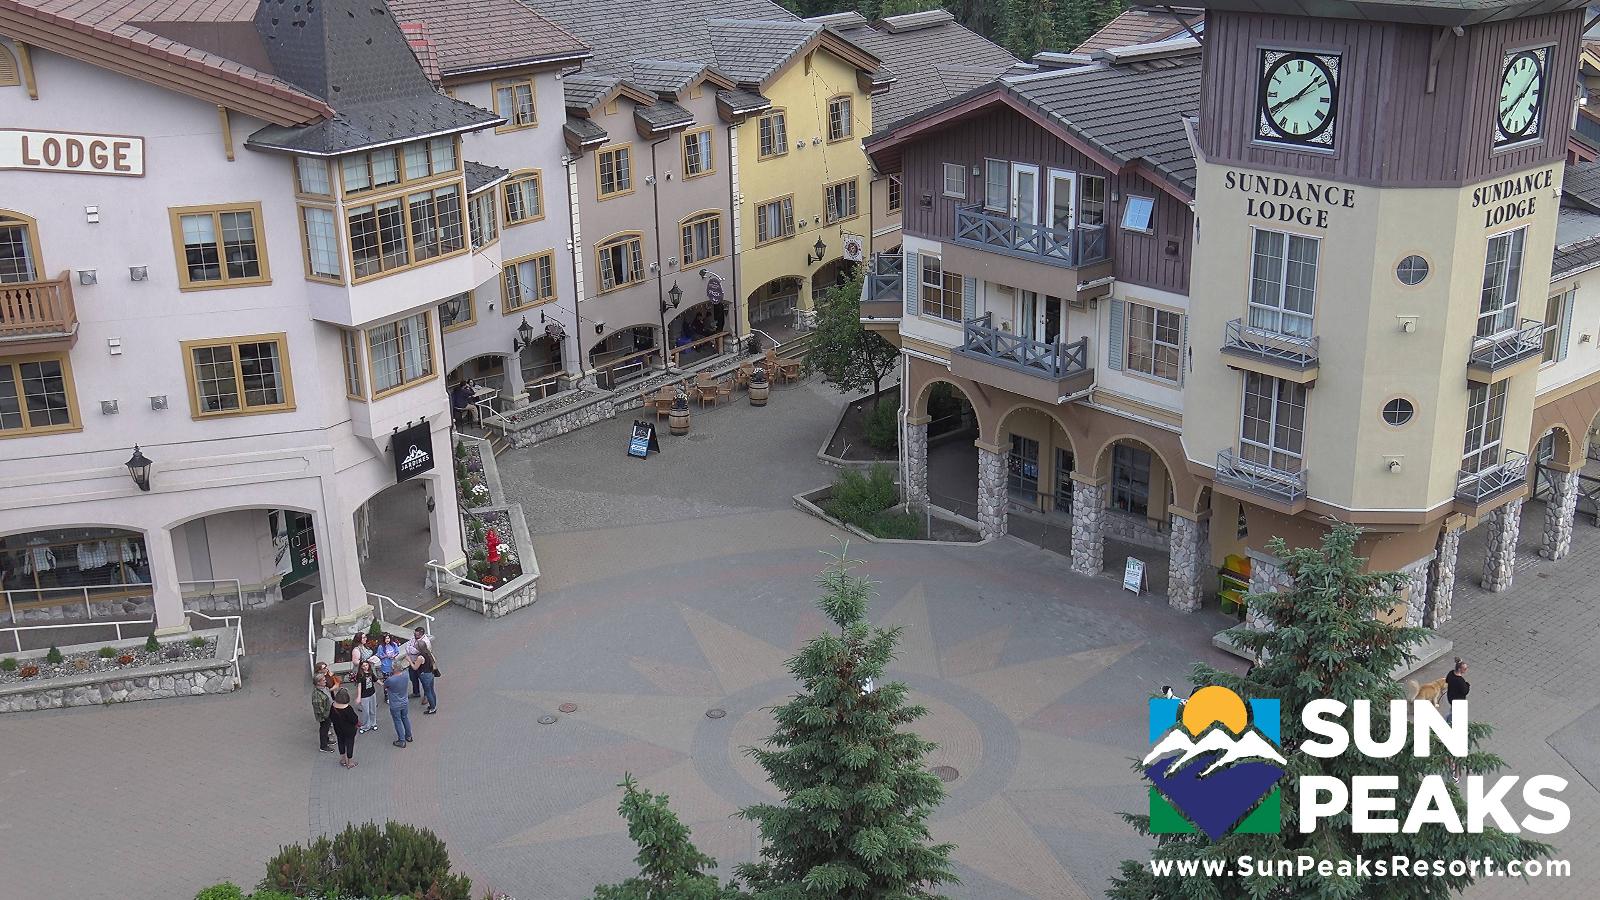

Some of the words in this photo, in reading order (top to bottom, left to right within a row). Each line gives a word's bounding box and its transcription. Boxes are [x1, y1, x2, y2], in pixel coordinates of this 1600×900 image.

[21, 135, 132, 172] LODGE
[1225, 171, 1355, 208] SUNDANCE
[1472, 169, 1553, 208] SUNDANCE
[1246, 198, 1329, 229] LODGE
[1485, 196, 1537, 229] LODGE
